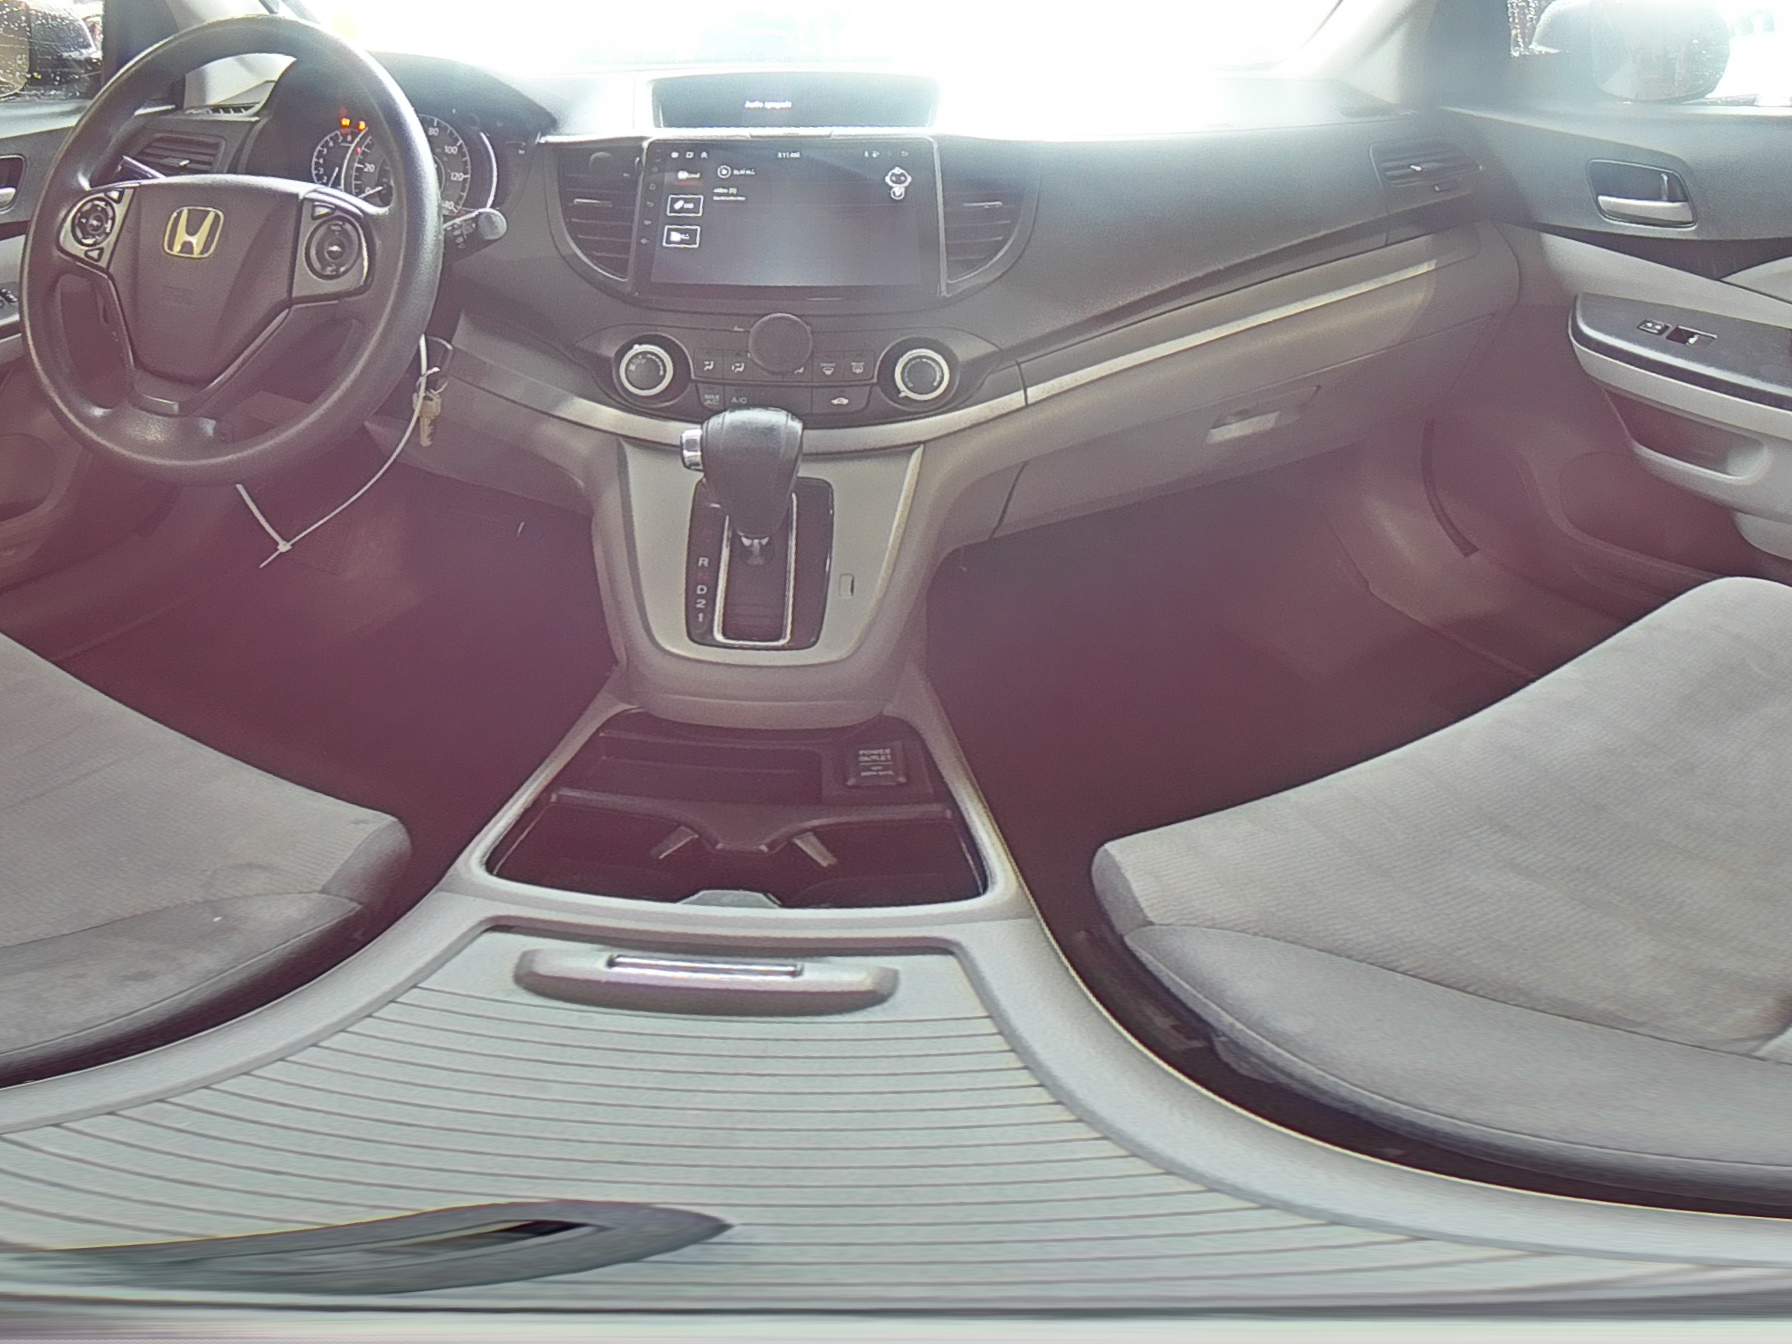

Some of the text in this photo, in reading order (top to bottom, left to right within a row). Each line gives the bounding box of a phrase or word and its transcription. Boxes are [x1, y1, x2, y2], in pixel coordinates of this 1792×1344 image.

[698, 557, 709, 567] R
[696, 584, 707, 595] D
[695, 598, 707, 609] 2
[697, 612, 704, 623] 1
